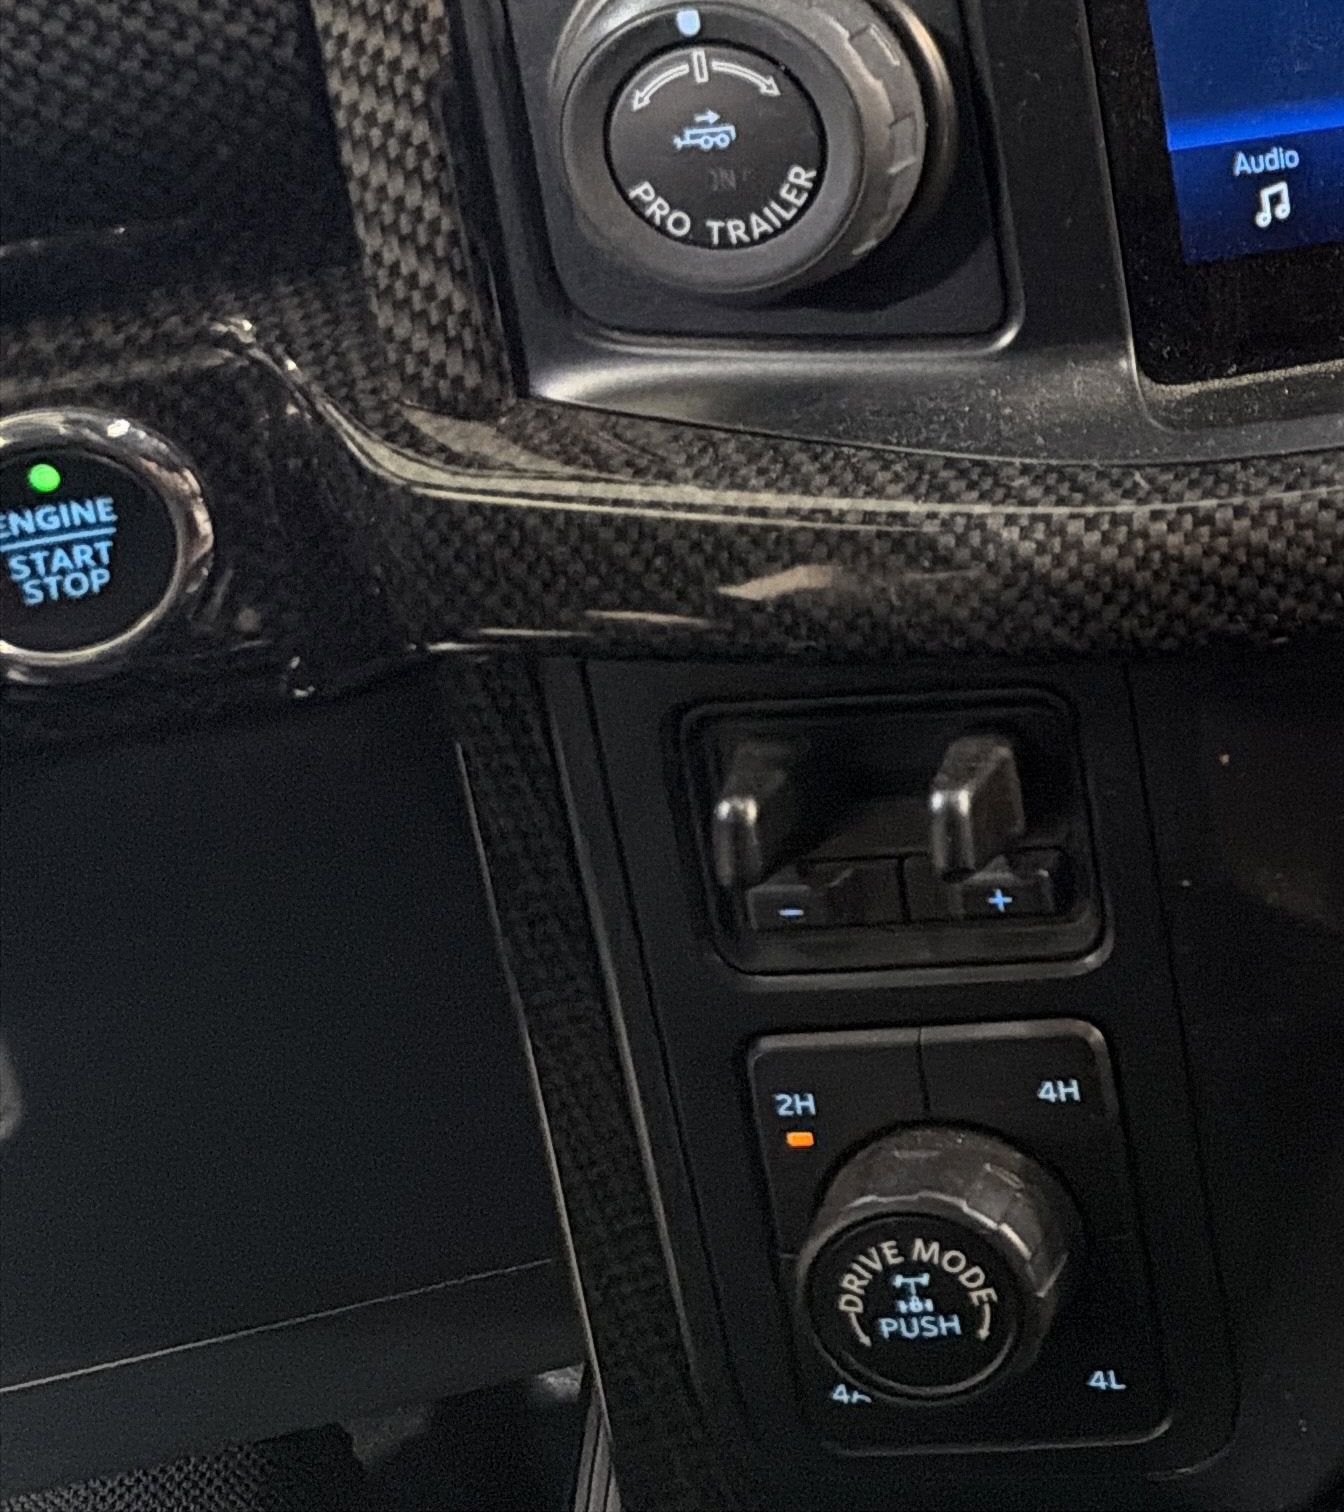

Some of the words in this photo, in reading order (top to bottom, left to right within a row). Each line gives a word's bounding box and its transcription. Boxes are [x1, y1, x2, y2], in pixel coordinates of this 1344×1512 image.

[1233, 146, 1300, 177] Audio
[629, 181, 693, 238] PRO
[706, 165, 817, 246] TRAILER
[8, 540, 114, 582] START
[22, 568, 111, 606] STOP
[774, 1093, 816, 1116] 2H
[1037, 1079, 1081, 1103] 4H
[838, 1238, 905, 1315] DRIVE
[911, 1238, 998, 1306] MODE
[878, 1314, 962, 1339] PUSH
[1087, 1369, 1127, 1391] 4L
